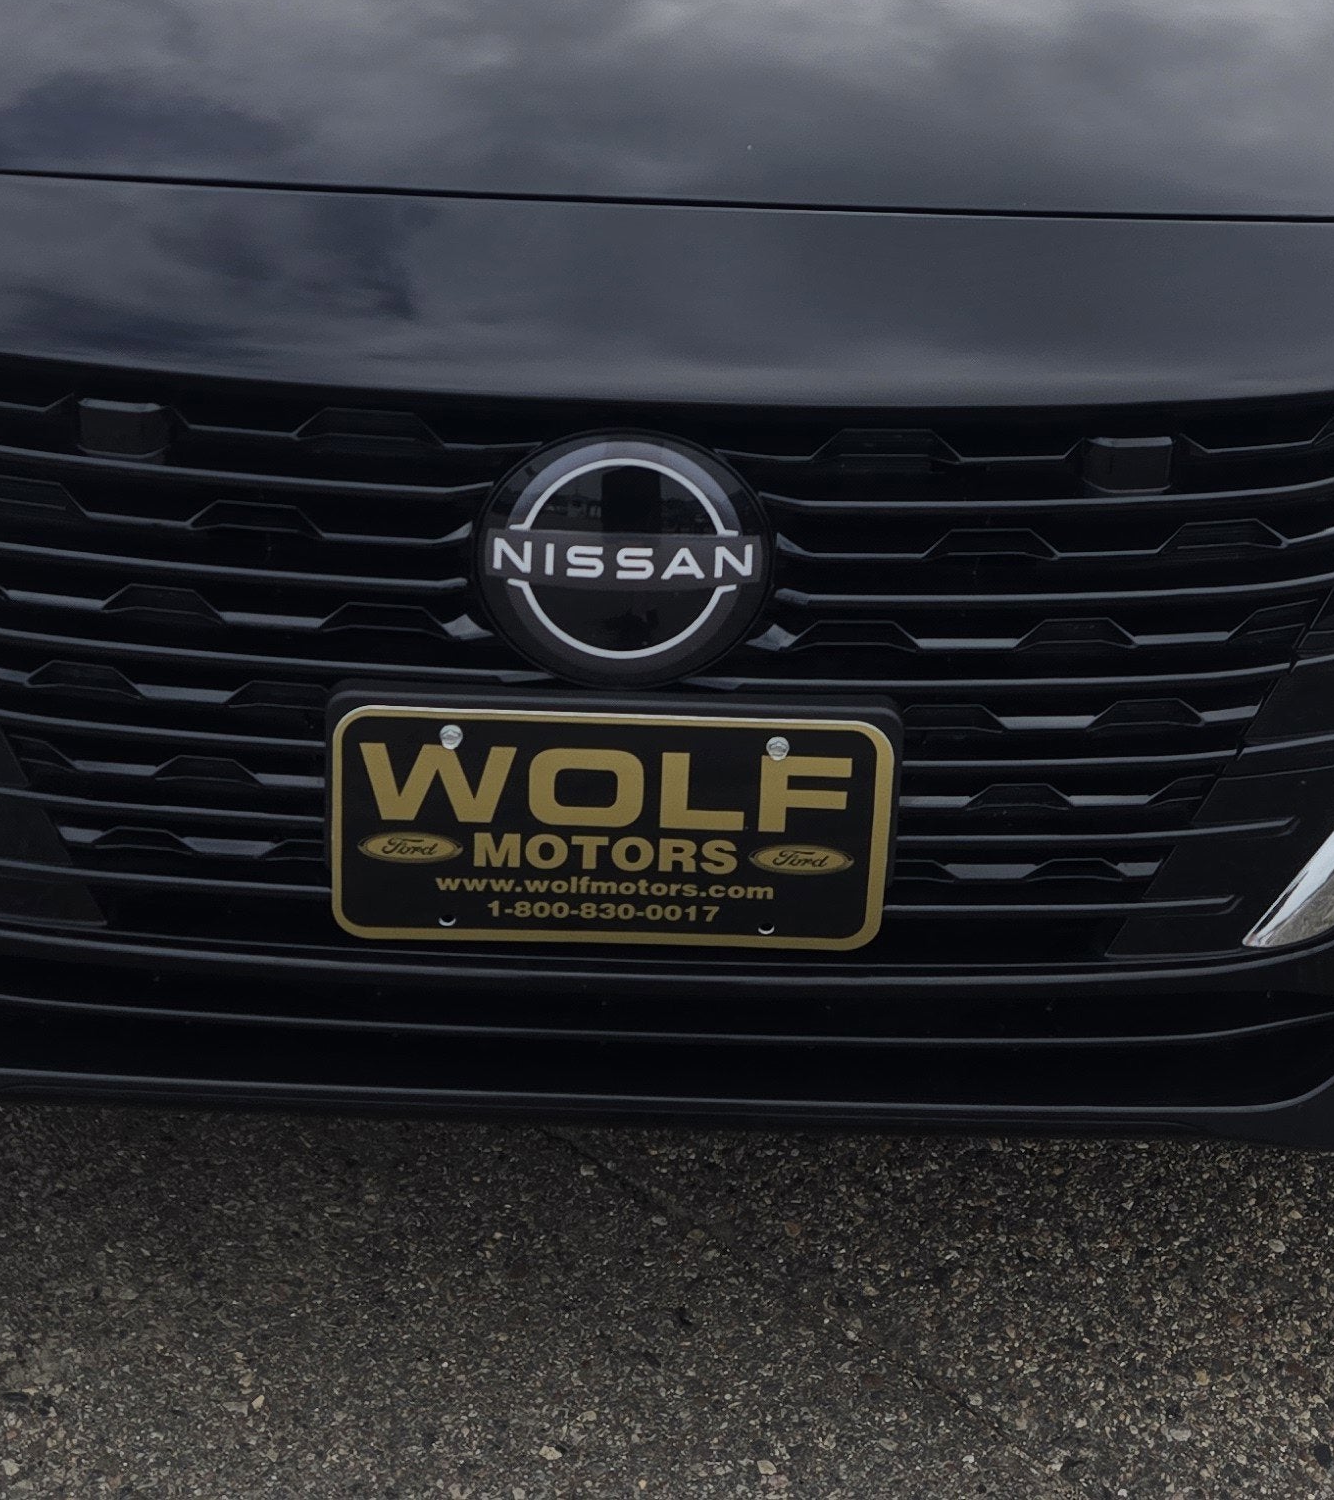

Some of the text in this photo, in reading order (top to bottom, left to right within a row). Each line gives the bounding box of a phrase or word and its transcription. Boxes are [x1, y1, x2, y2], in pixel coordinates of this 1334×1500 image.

[492, 537, 753, 580] NISSAN
[359, 742, 854, 833] WOLF
[382, 838, 439, 856] Ford
[473, 833, 738, 876] MOTORS
[772, 849, 829, 868] Ford
[435, 874, 775, 901] www.wolfmotors.com
[487, 900, 720, 923] 1-800-830-0017
